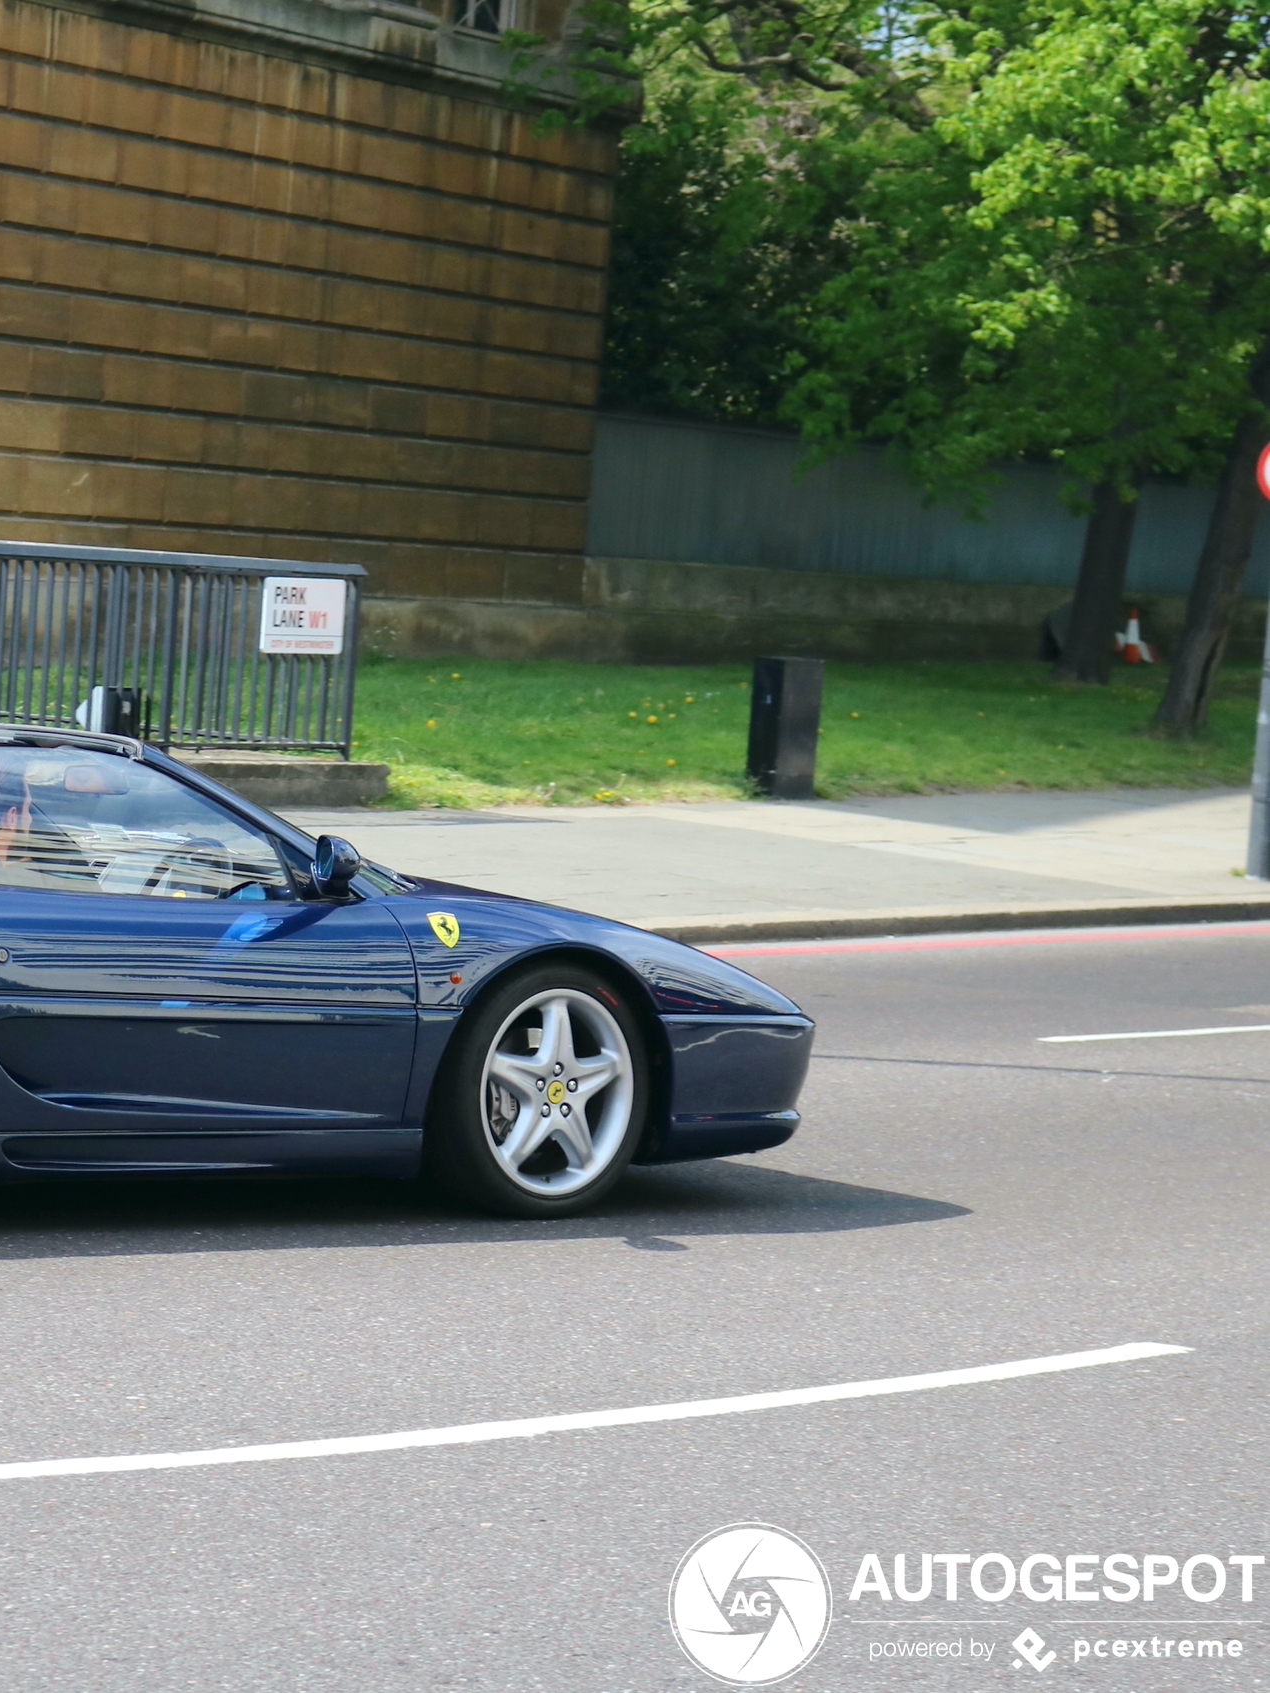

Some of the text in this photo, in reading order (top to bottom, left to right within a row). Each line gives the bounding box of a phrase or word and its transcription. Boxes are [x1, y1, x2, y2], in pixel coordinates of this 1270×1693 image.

[274, 586, 307, 605] PARK
[273, 609, 328, 629] LANE W1
